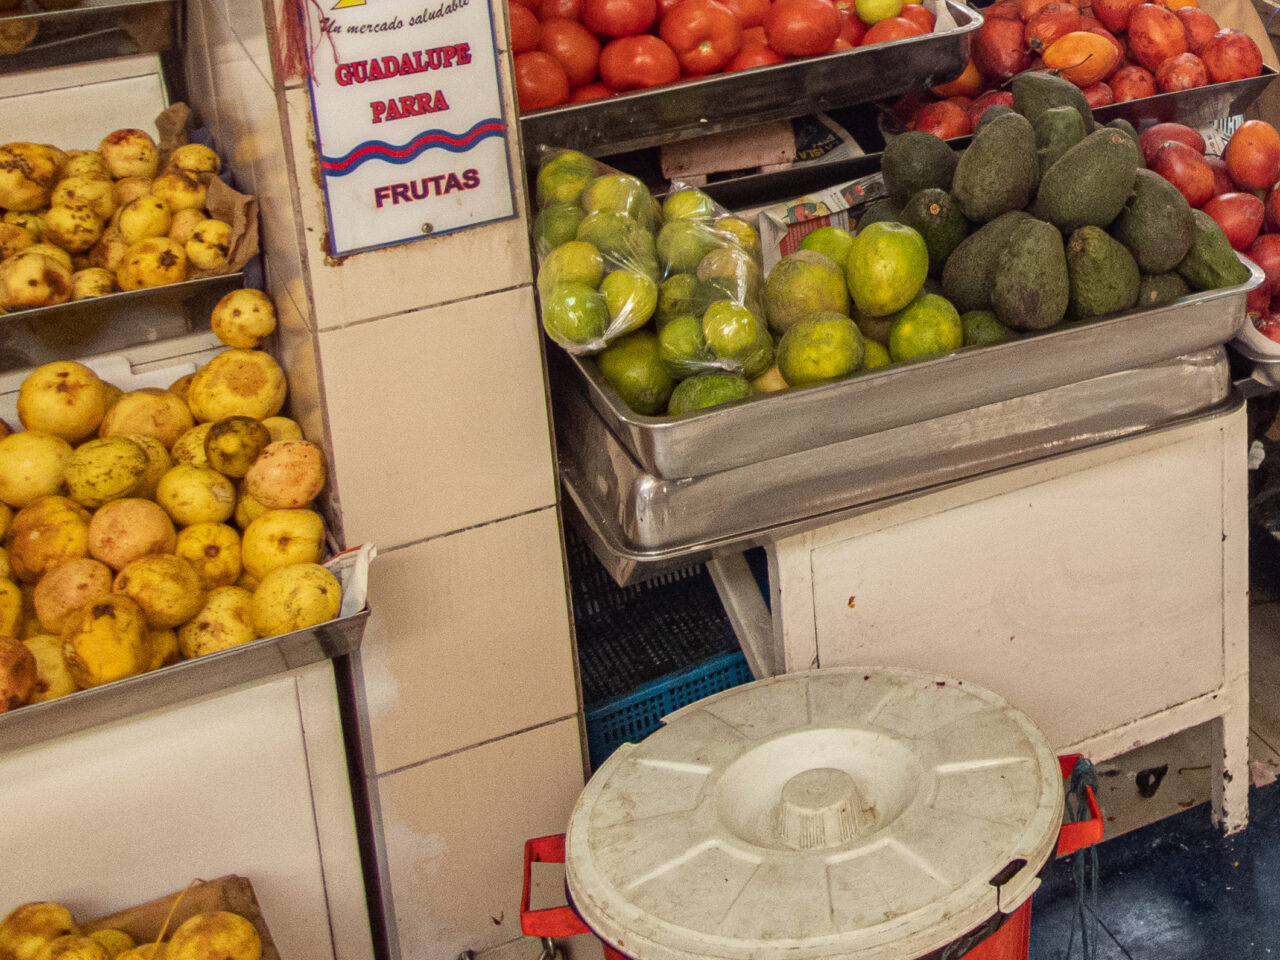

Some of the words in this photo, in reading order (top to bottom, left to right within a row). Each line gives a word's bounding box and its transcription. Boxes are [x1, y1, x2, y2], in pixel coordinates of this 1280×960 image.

[347, 16, 403, 34] mercado
[335, 42, 472, 87] GUADALUPE
[370, 90, 450, 124] PARRA
[374, 168, 481, 208] FRUTAS
